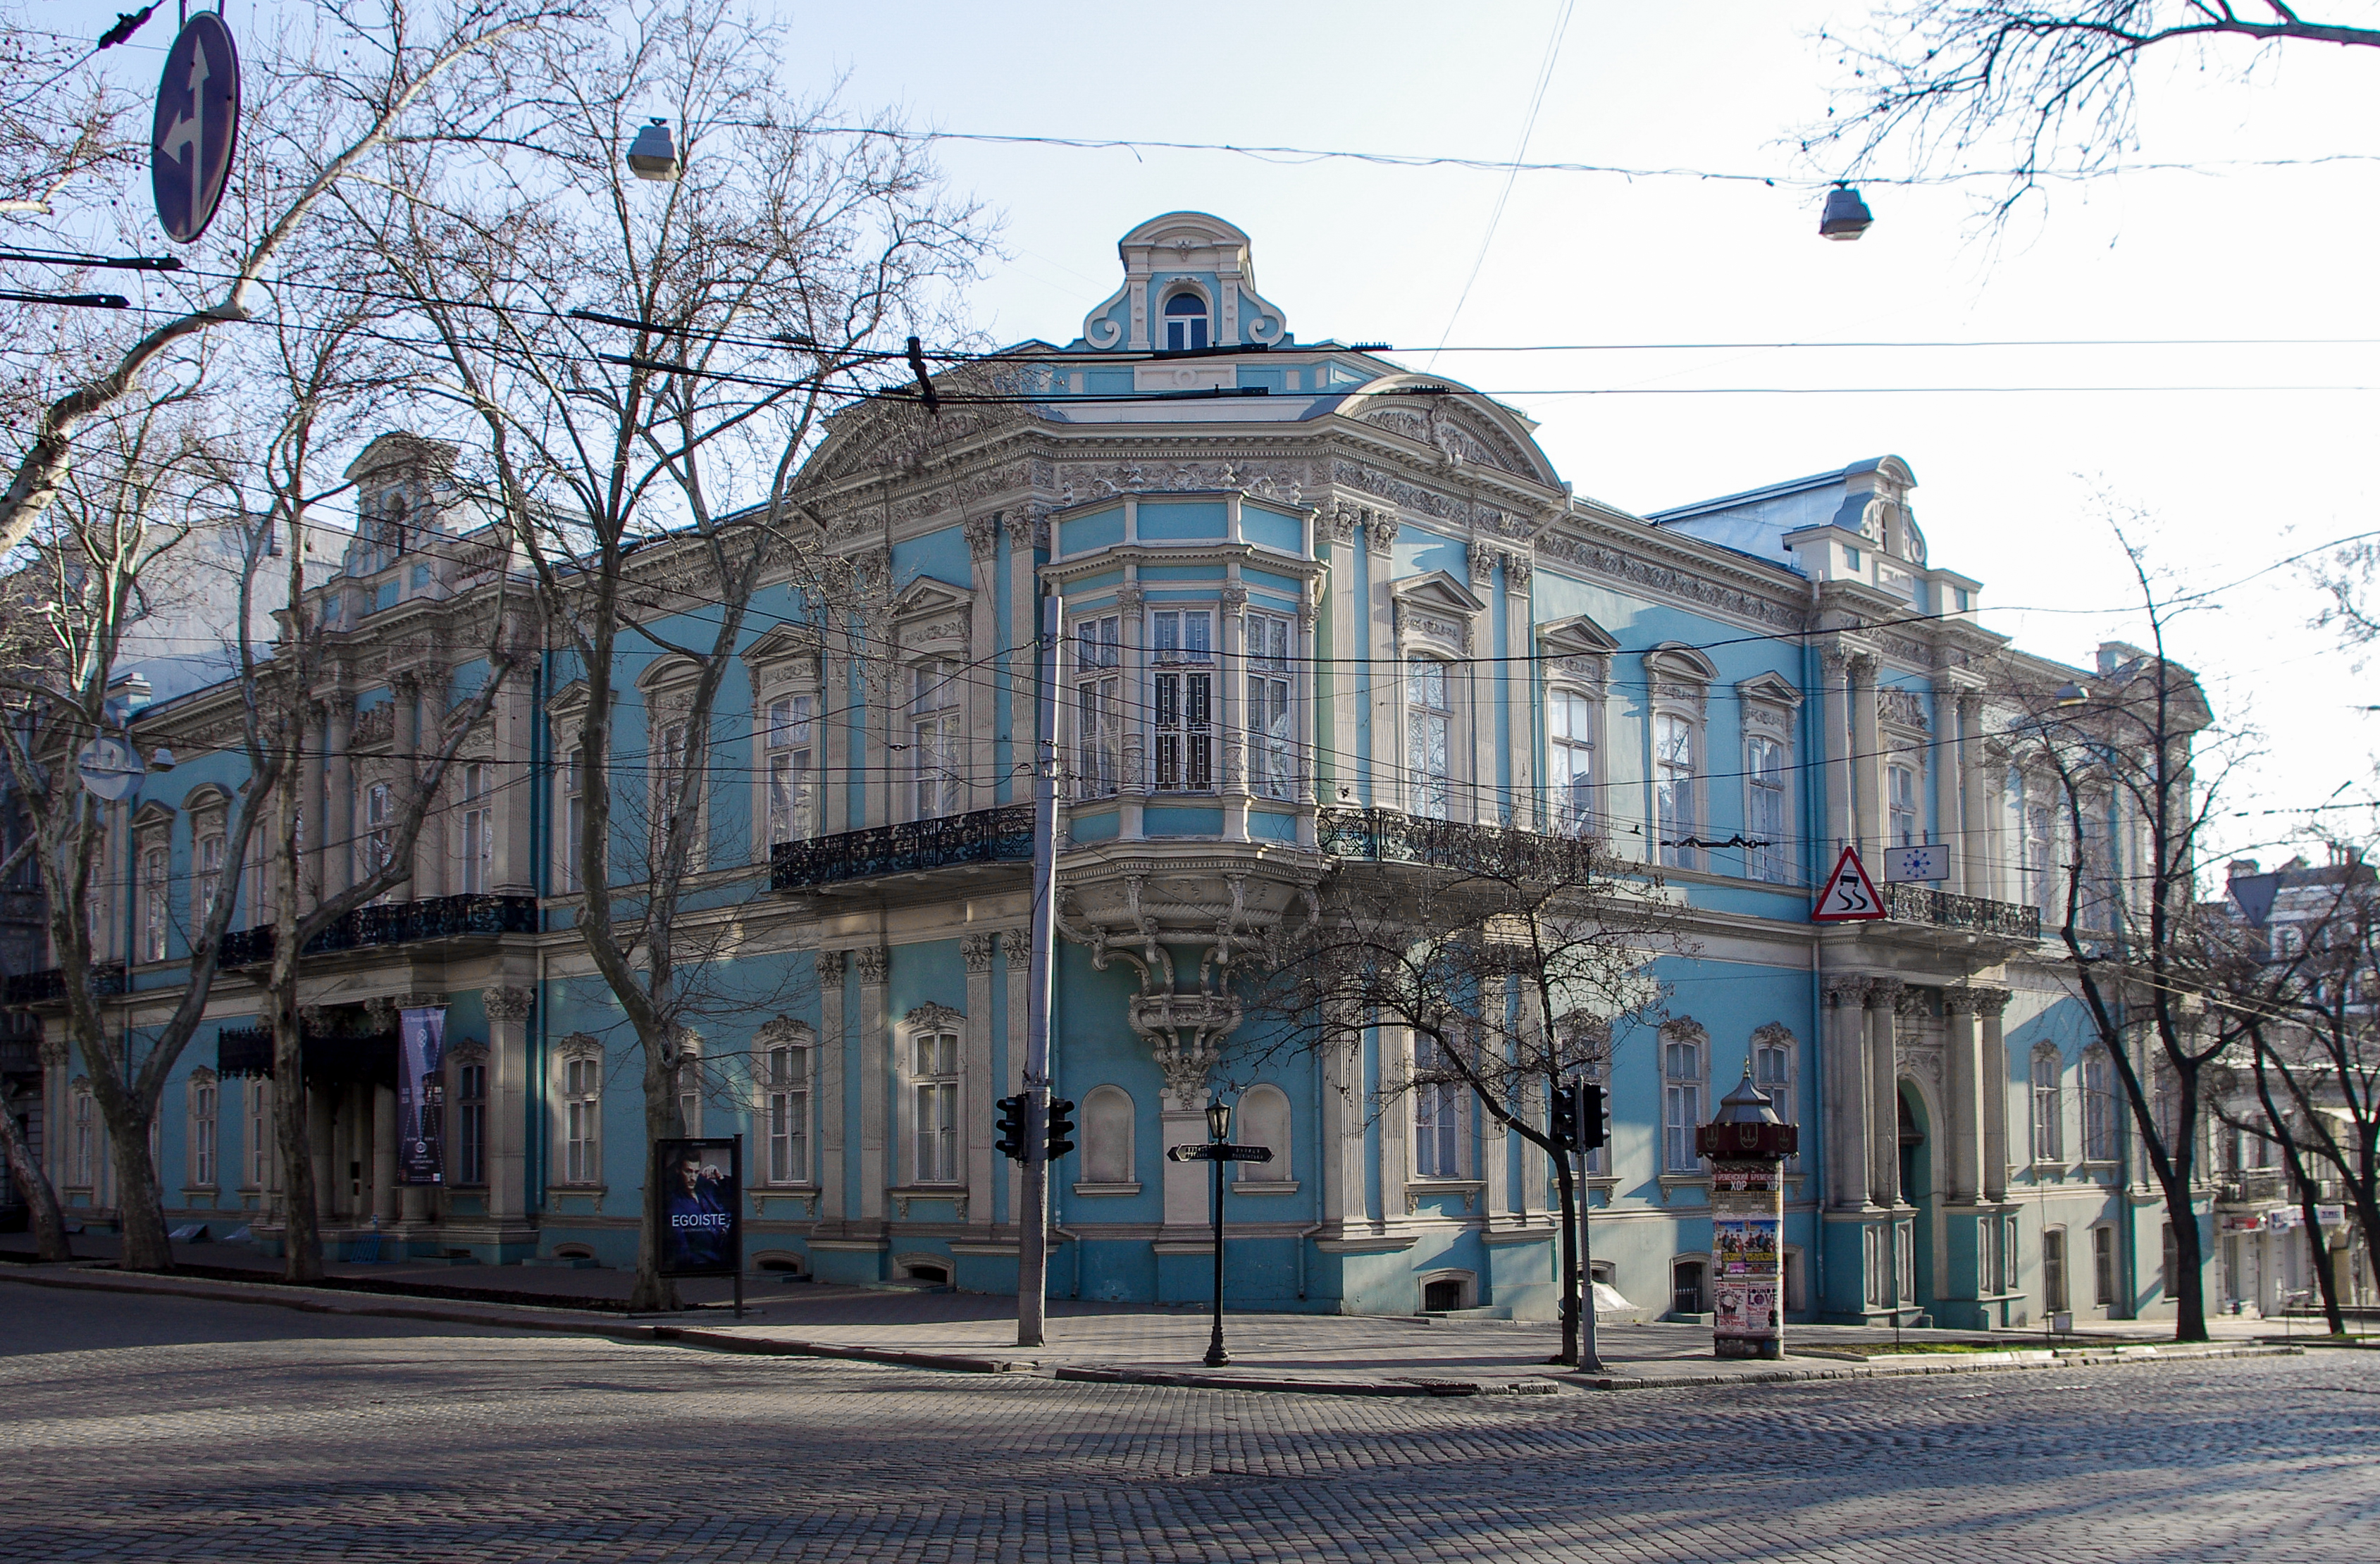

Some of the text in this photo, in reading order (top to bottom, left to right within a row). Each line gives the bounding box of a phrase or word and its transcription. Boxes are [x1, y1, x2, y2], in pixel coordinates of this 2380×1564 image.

[1730, 1180, 1747, 1191] ХОР
[672, 1214, 726, 1227] EGOISTE
[1747, 1294, 1778, 1305] LOVE
